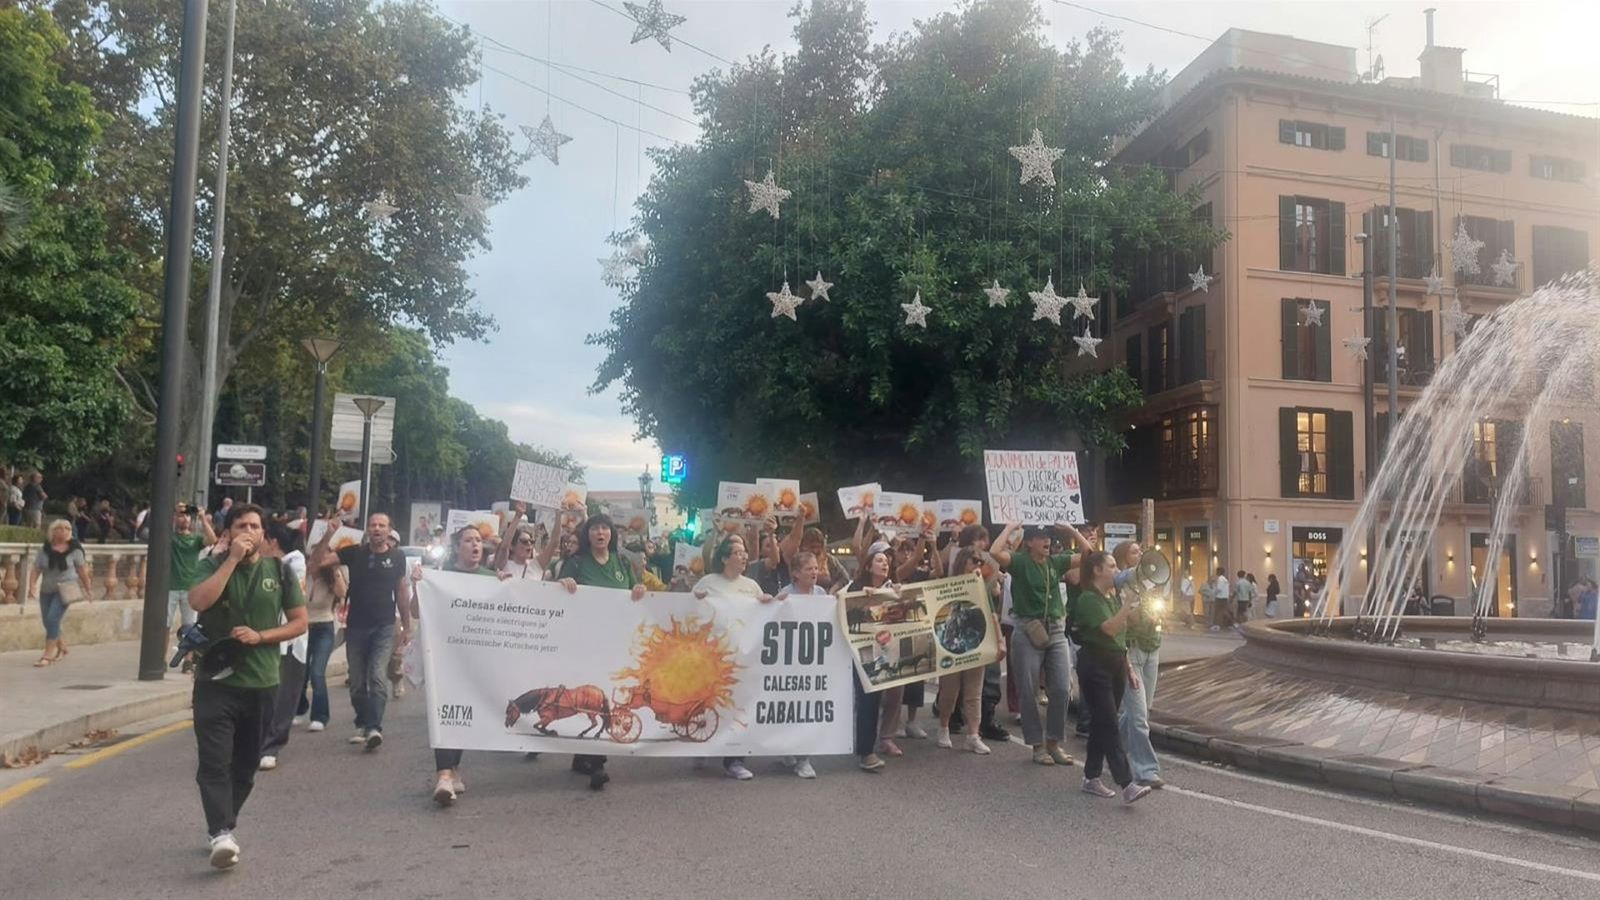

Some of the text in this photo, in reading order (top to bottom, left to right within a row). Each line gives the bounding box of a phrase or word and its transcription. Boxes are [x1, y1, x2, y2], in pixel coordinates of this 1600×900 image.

[988, 470, 1024, 493] FUND
[1028, 470, 1060, 481] ELECTRIC
[992, 494, 1020, 521] FREE
[1030, 495, 1067, 509] HORSES
[1023, 511, 1033, 520] TO
[1308, 532, 1327, 540] BOSS
[451, 598, 565, 619] ¡Calesas eléctricas ya!
[462, 625, 491, 635] Electric
[493, 627, 528, 639] carriages
[502, 640, 539, 651] Kutschen
[761, 621, 833, 666] STOP
[763, 675, 828, 691] CALESAS DE
[441, 704, 473, 721] SATYA
[756, 700, 835, 725] CABALLOS
[440, 719, 472, 728] ANIMAL
